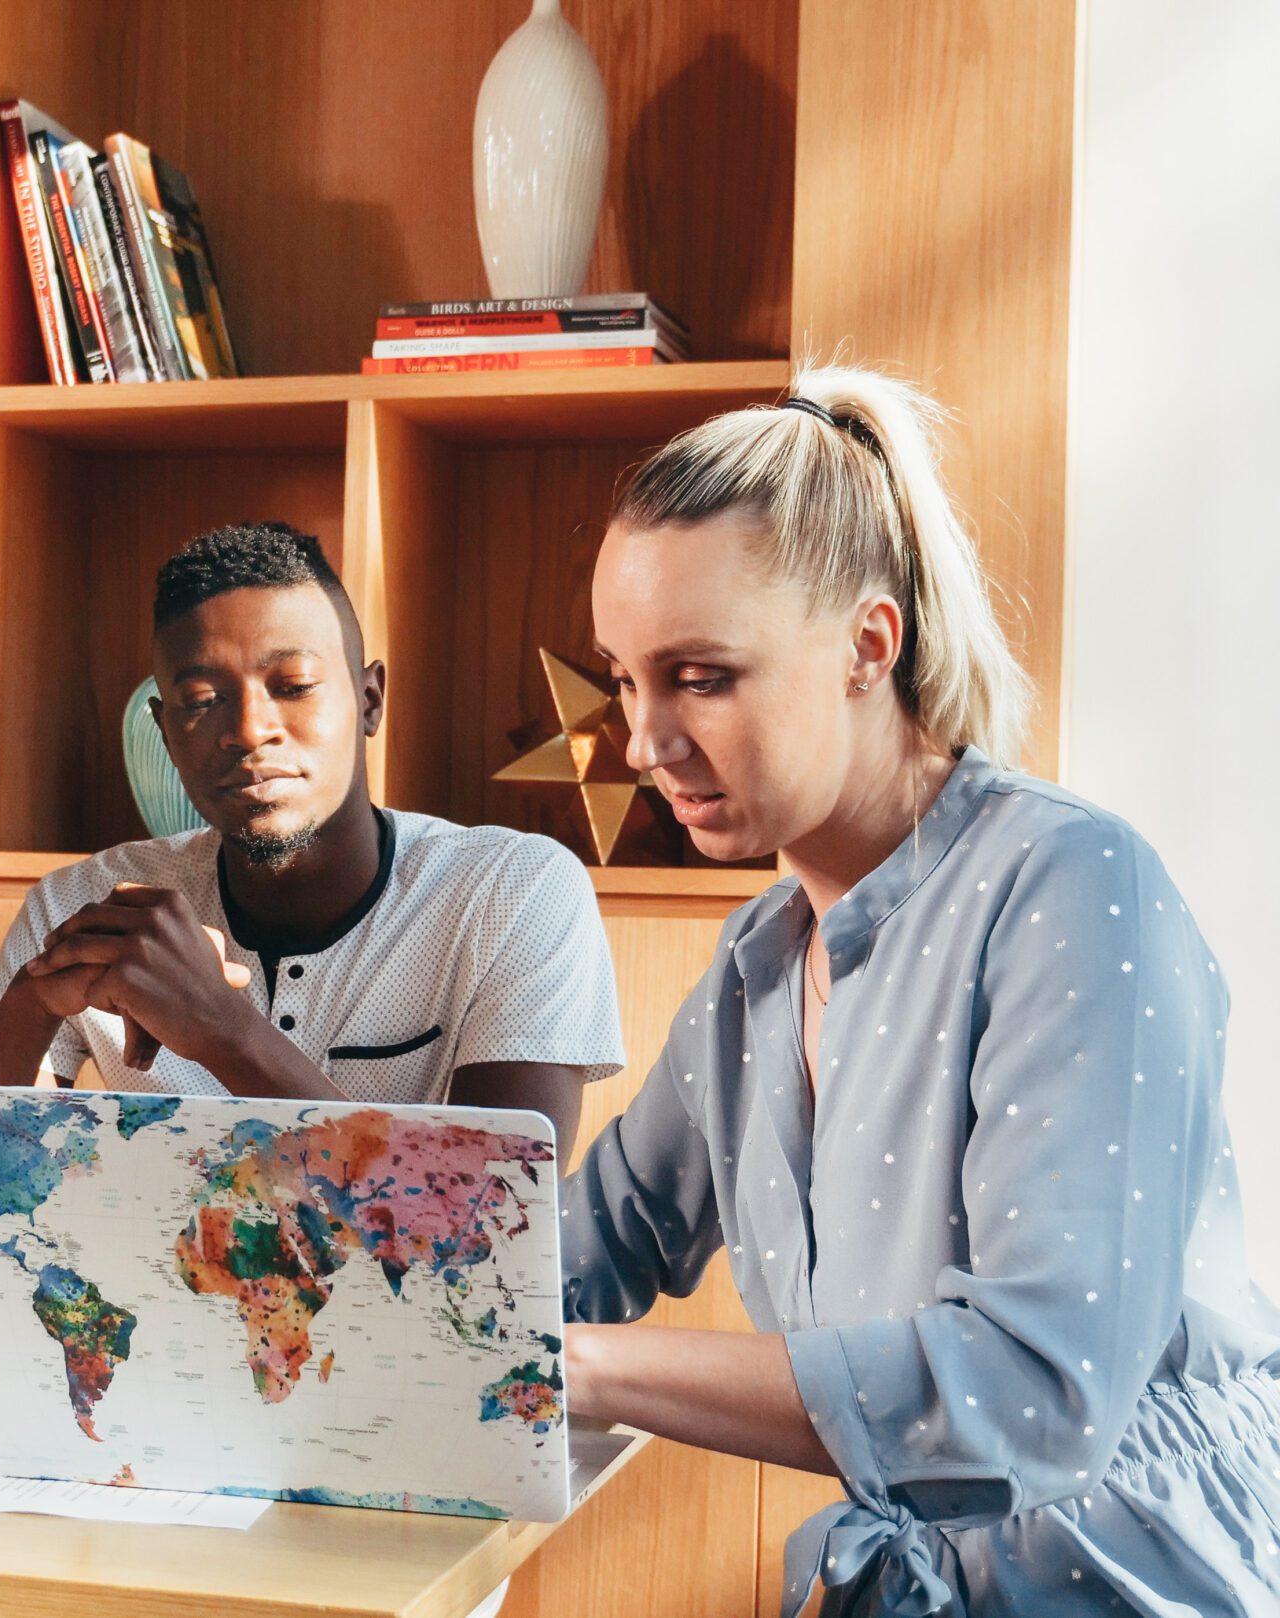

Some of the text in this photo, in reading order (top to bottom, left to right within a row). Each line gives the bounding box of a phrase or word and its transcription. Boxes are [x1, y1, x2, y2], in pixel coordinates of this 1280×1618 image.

[17, 180, 50, 290] IN THE STUDIO
[99, 172, 122, 235] CONTEMPORARY
[114, 236, 130, 266] STUDIO
[49, 192, 91, 326] THE ESSENTIAL ROBERT INDIANA
[477, 301, 505, 313] ART
[507, 301, 517, 312] &
[522, 298, 573, 311] DESIGN
[389, 343, 426, 353] TAKING
[430, 342, 460, 351] SHAPE
[395, 352, 520, 374] MODERN
